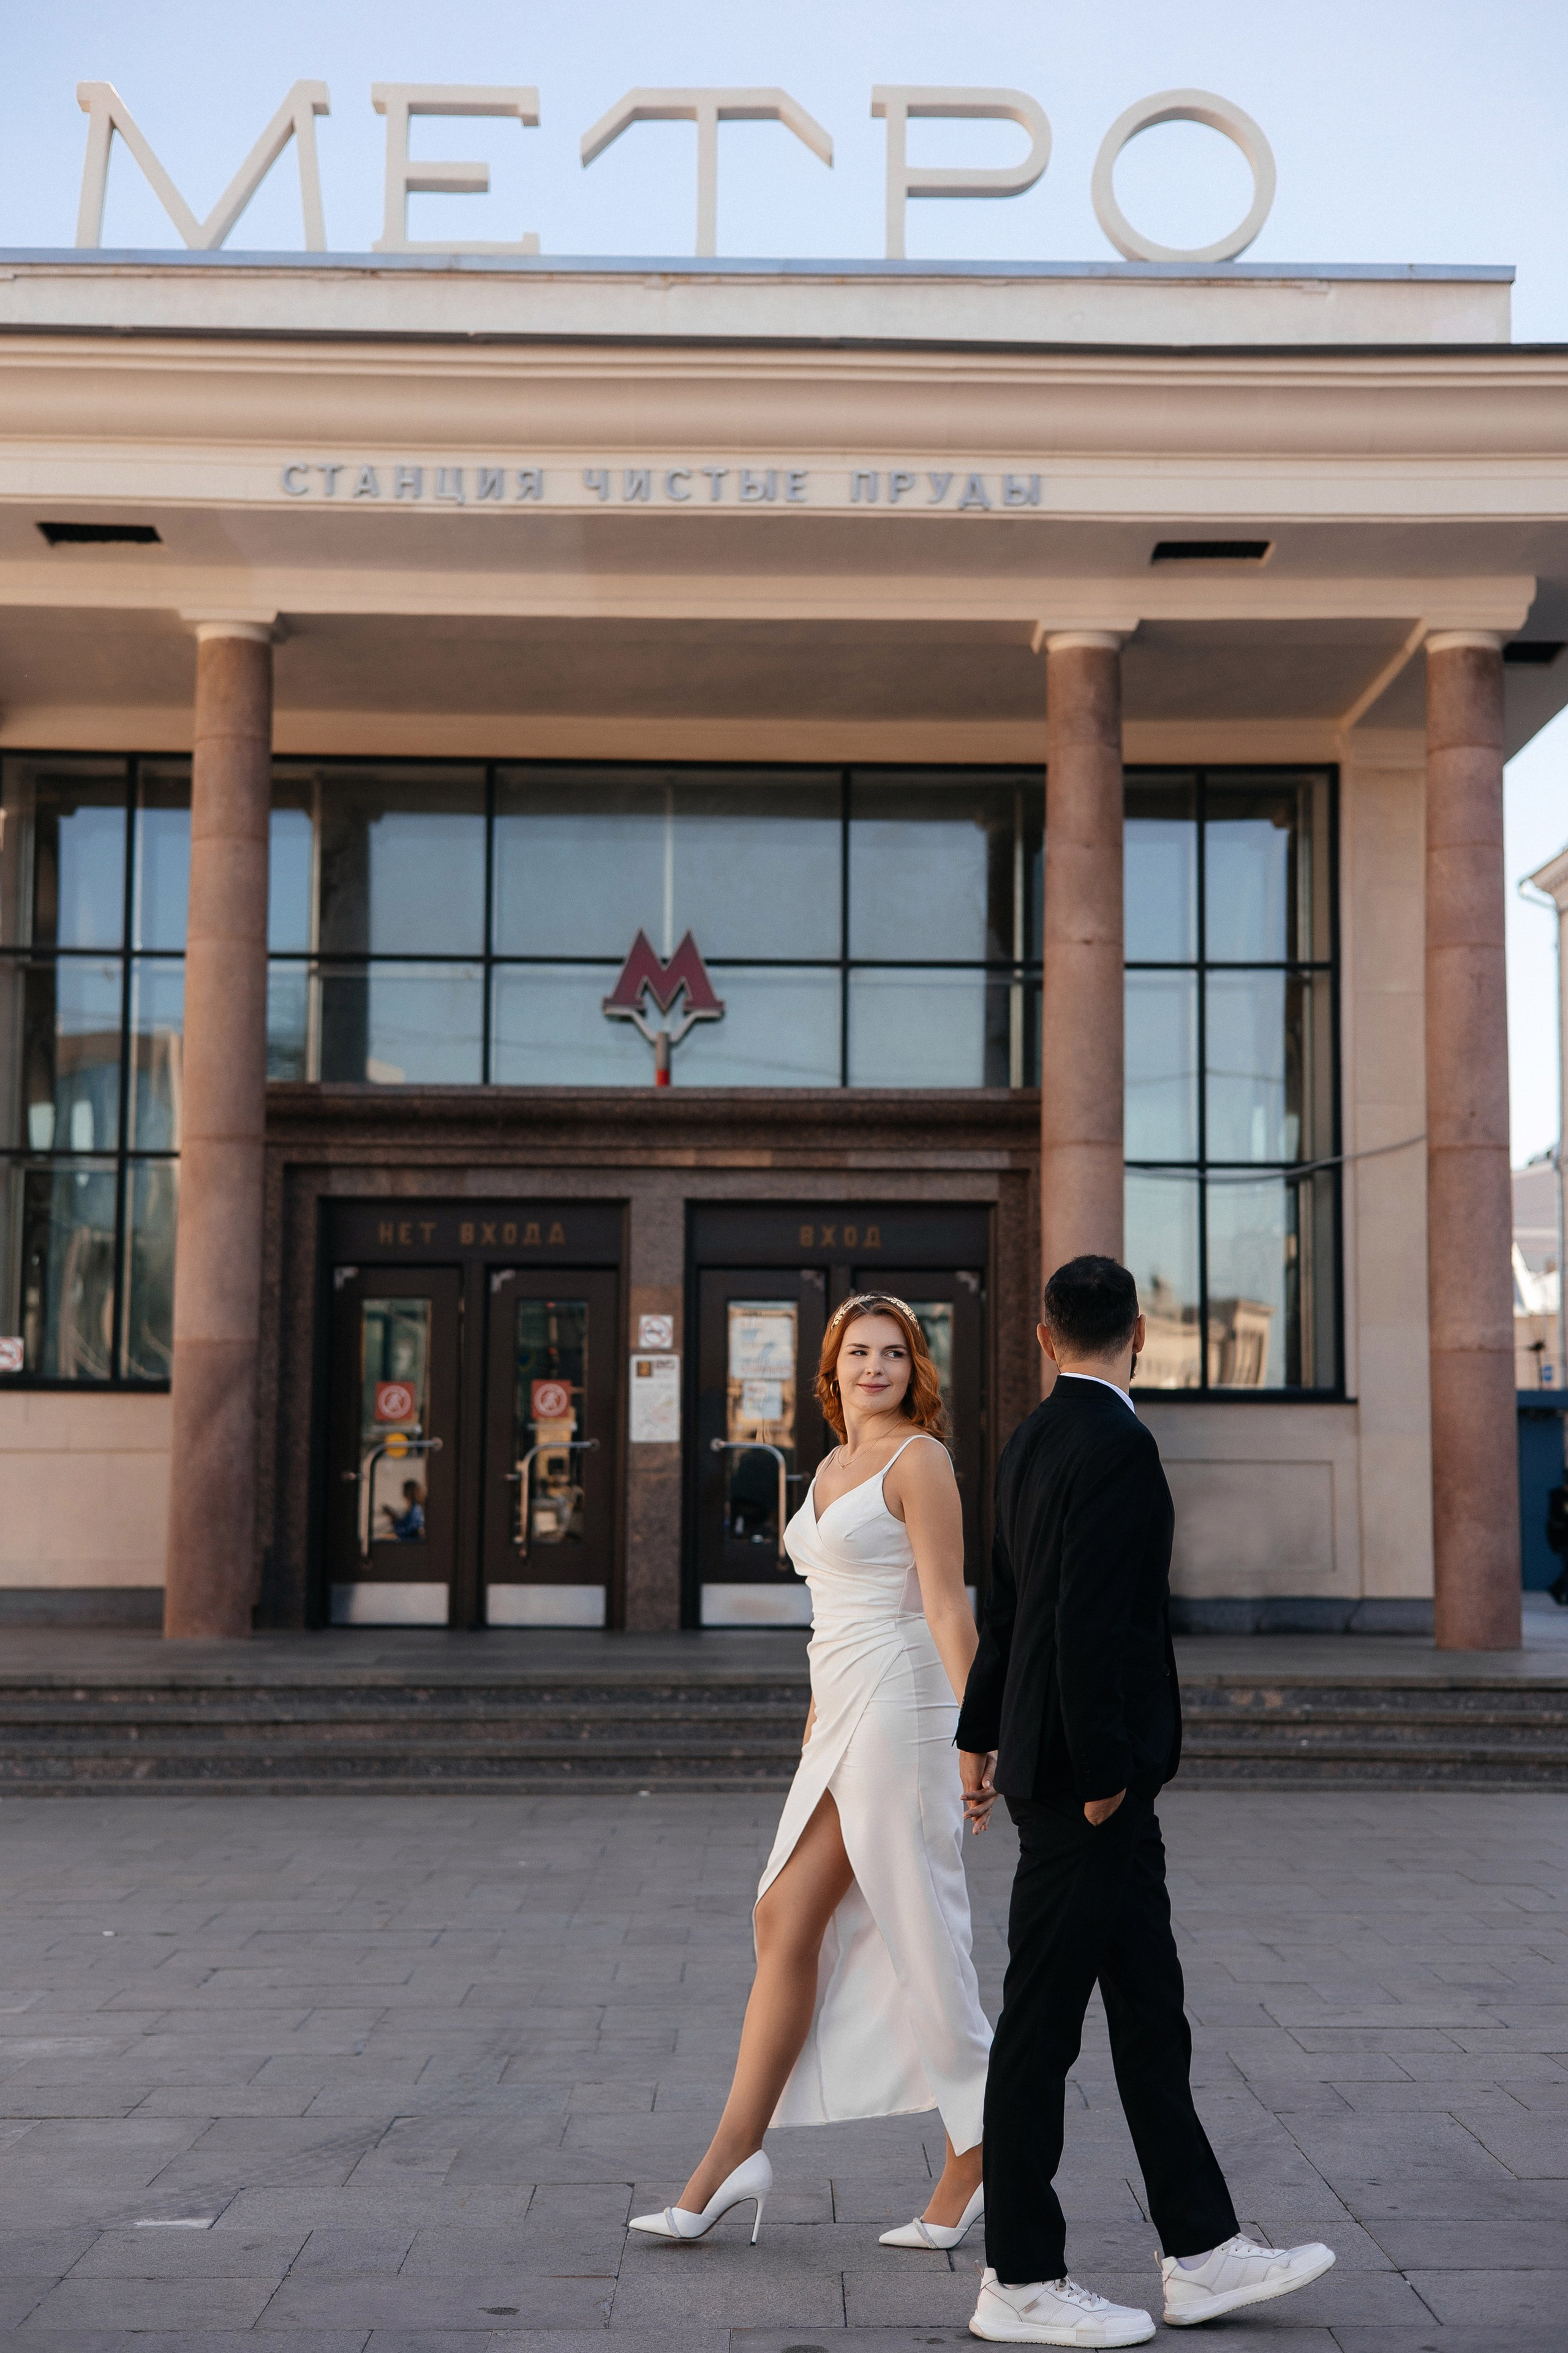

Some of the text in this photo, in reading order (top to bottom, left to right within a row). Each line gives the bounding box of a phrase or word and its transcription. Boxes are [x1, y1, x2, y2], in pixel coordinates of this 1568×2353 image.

[75, 80, 1277, 263] МЕТРО
[282, 462, 1042, 511] СТАНЦИЯ ЧИСТЫЕ ПРУДЫ
[379, 1221, 567, 1246] НЕТ ВХОДА
[799, 1225, 883, 1248] ВХОД
